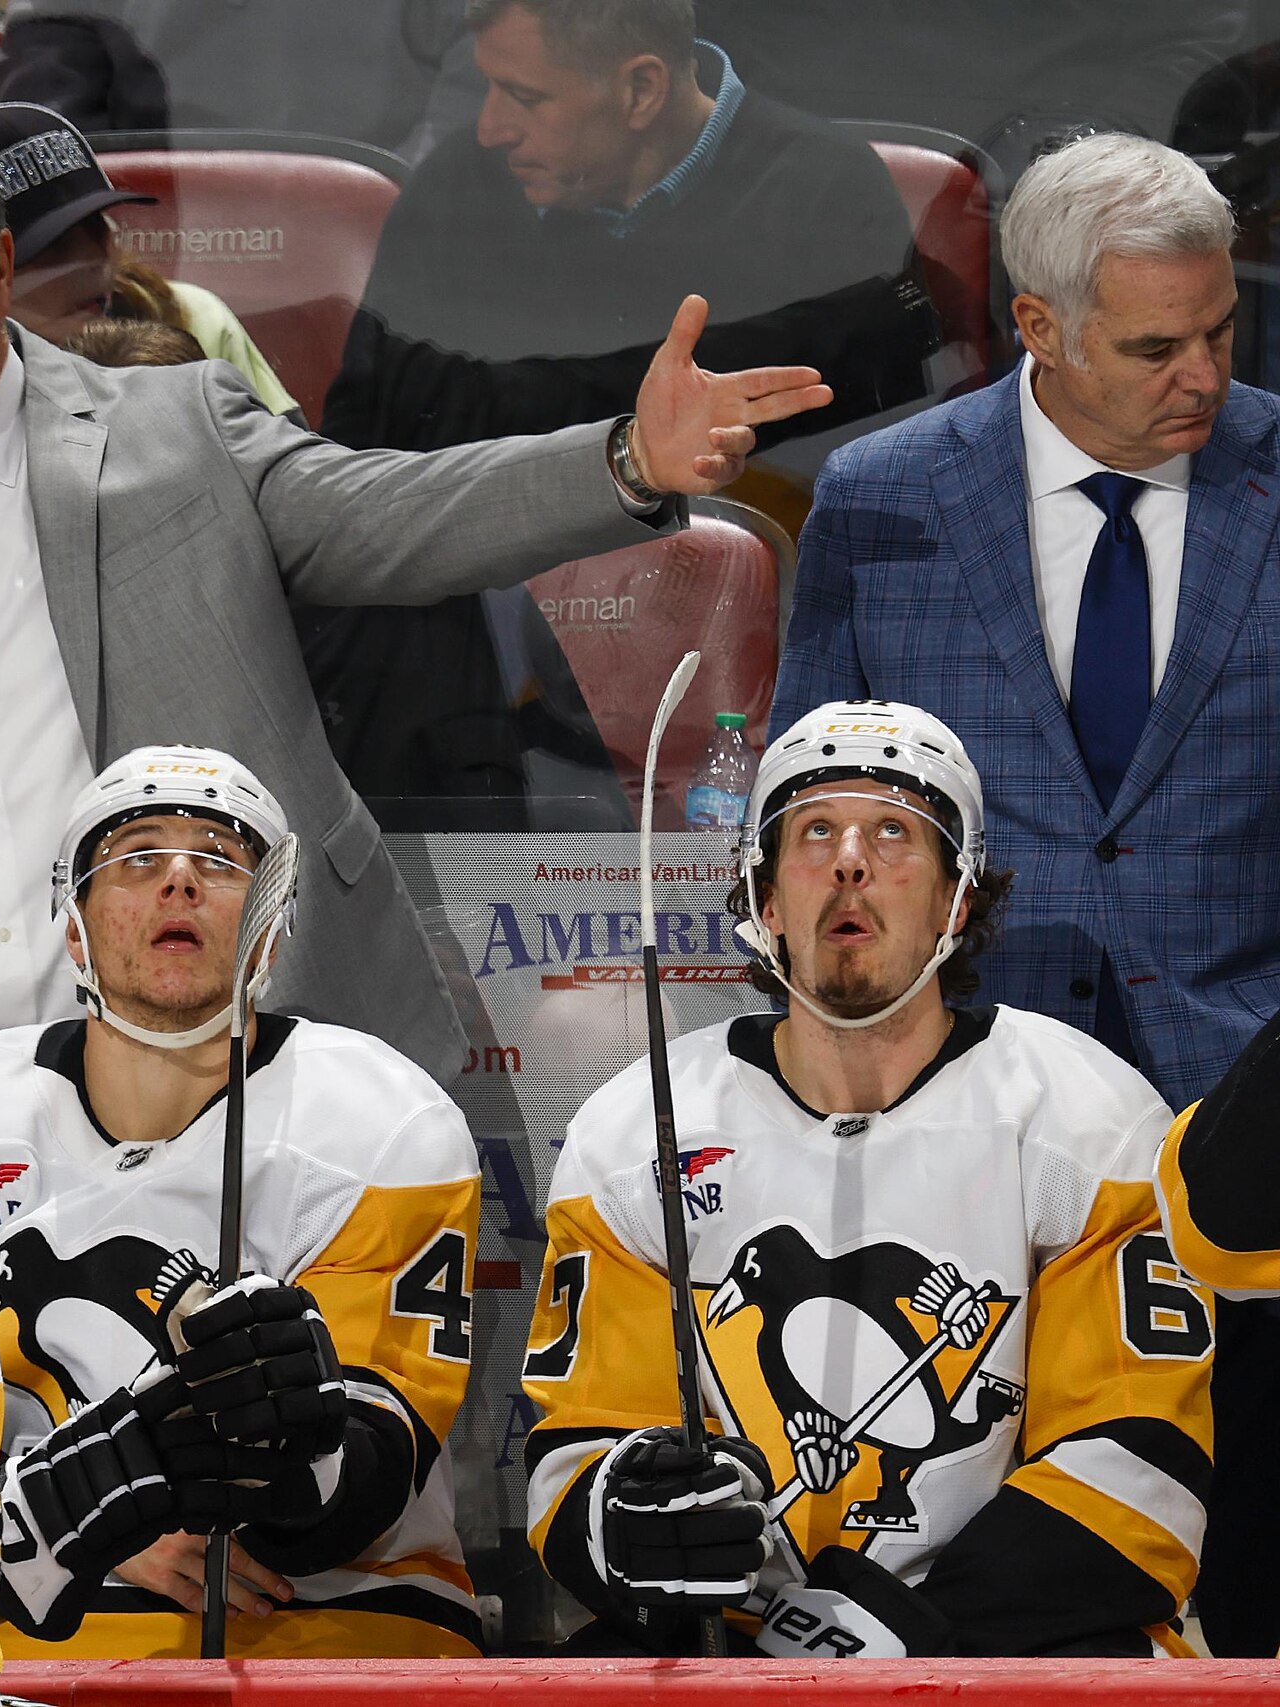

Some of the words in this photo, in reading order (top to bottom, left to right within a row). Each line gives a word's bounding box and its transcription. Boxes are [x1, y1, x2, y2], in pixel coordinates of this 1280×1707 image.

[112, 226, 284, 252] immerman
[826, 724, 900, 735] CCM
[146, 764, 219, 776] CCM
